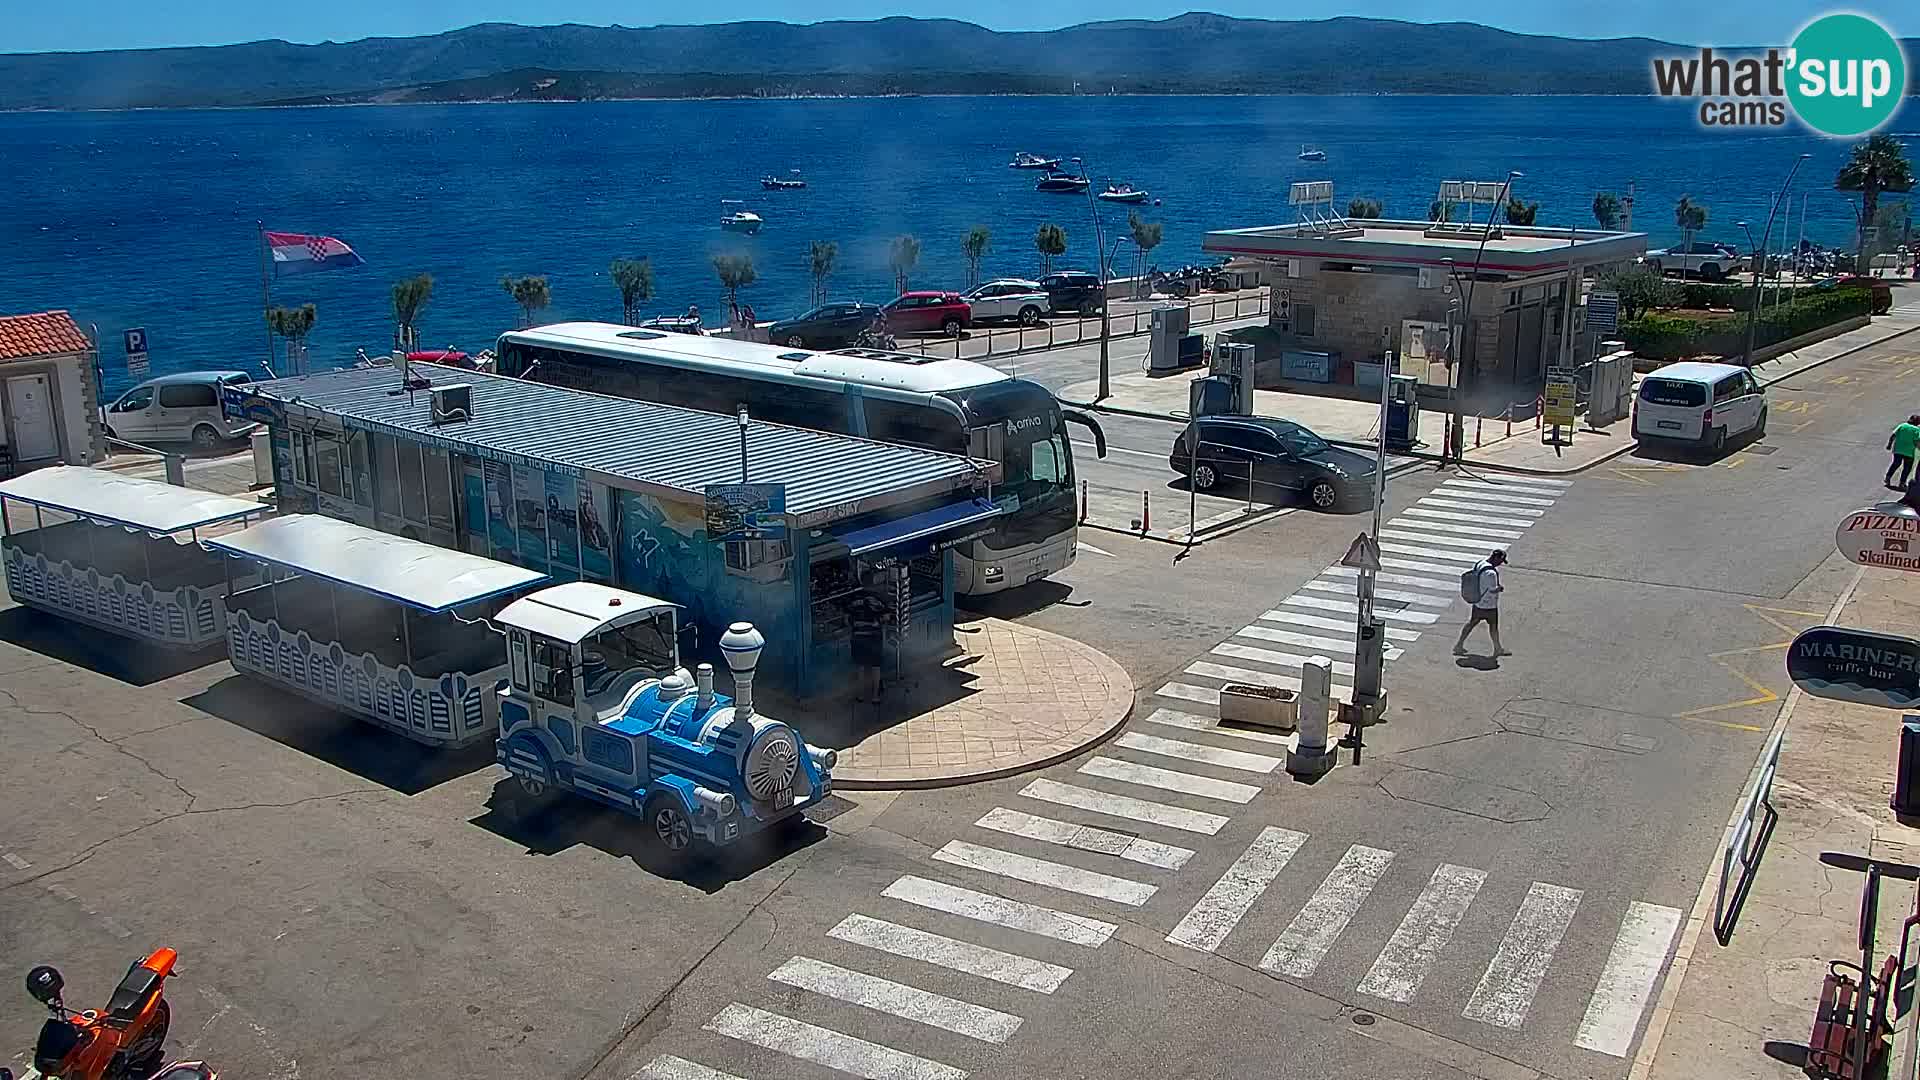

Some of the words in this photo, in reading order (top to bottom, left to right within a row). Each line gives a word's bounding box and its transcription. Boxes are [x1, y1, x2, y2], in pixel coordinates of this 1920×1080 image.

[129, 332, 141, 350] P
[1665, 381, 1684, 389] TAXI
[1016, 415, 1041, 430] arriva
[494, 449, 525, 465] STATION
[527, 457, 553, 472] TICKET
[554, 463, 581, 477] OFFICE
[1847, 515, 1920, 533] PIZZE
[1880, 530, 1917, 541] GRILL
[1827, 662, 1864, 673] caffe
[1869, 665, 1896, 680] bar
